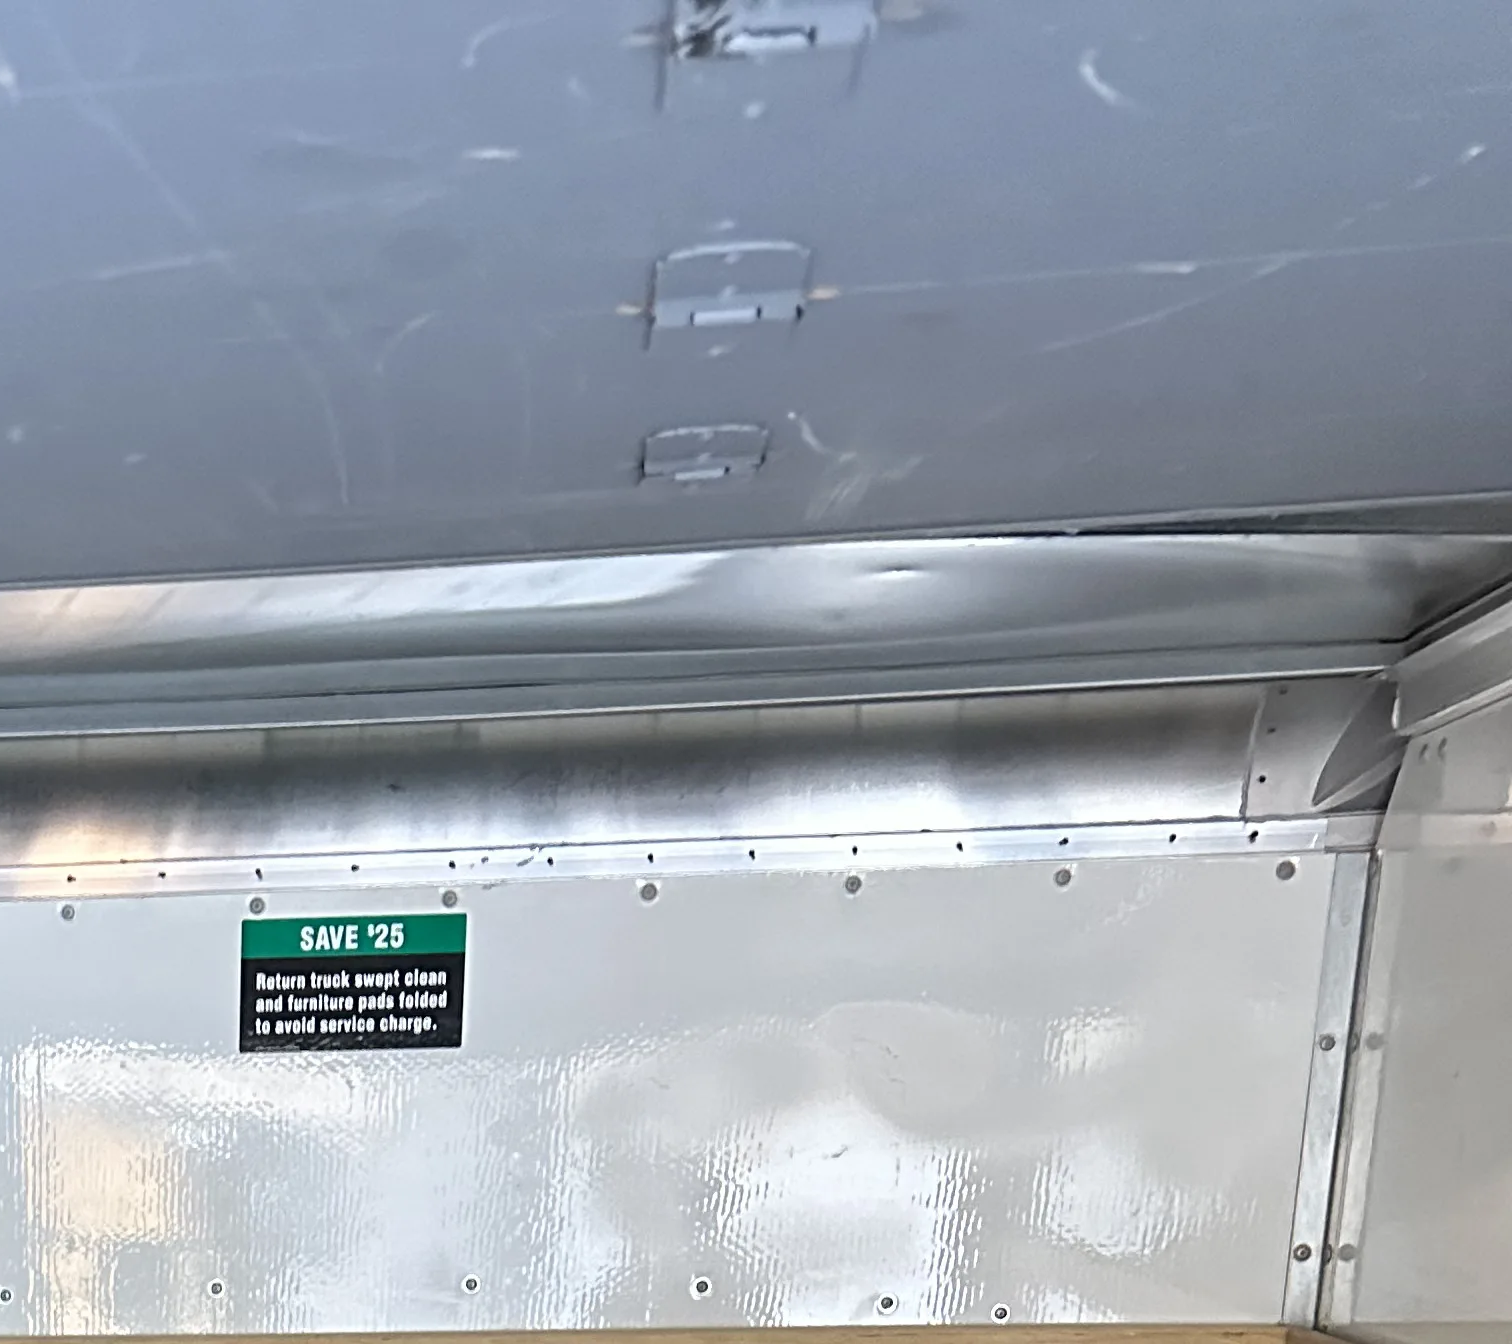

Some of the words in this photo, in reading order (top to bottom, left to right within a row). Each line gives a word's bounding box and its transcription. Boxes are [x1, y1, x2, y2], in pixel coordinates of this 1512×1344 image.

[300, 924, 359, 951] SAVE
[255, 971, 306, 991] Return
[310, 970, 350, 989] truck
[354, 969, 400, 991] swept
[404, 968, 447, 988] clean
[255, 995, 283, 1013] and
[287, 992, 354, 1012] furniture
[358, 991, 395, 1013] pads
[399, 990, 448, 1009] folded
[255, 1017, 271, 1035] to
[274, 1016, 316, 1035] avoid
[319, 1015, 375, 1034] service
[379, 1013, 438, 1035] charge.
